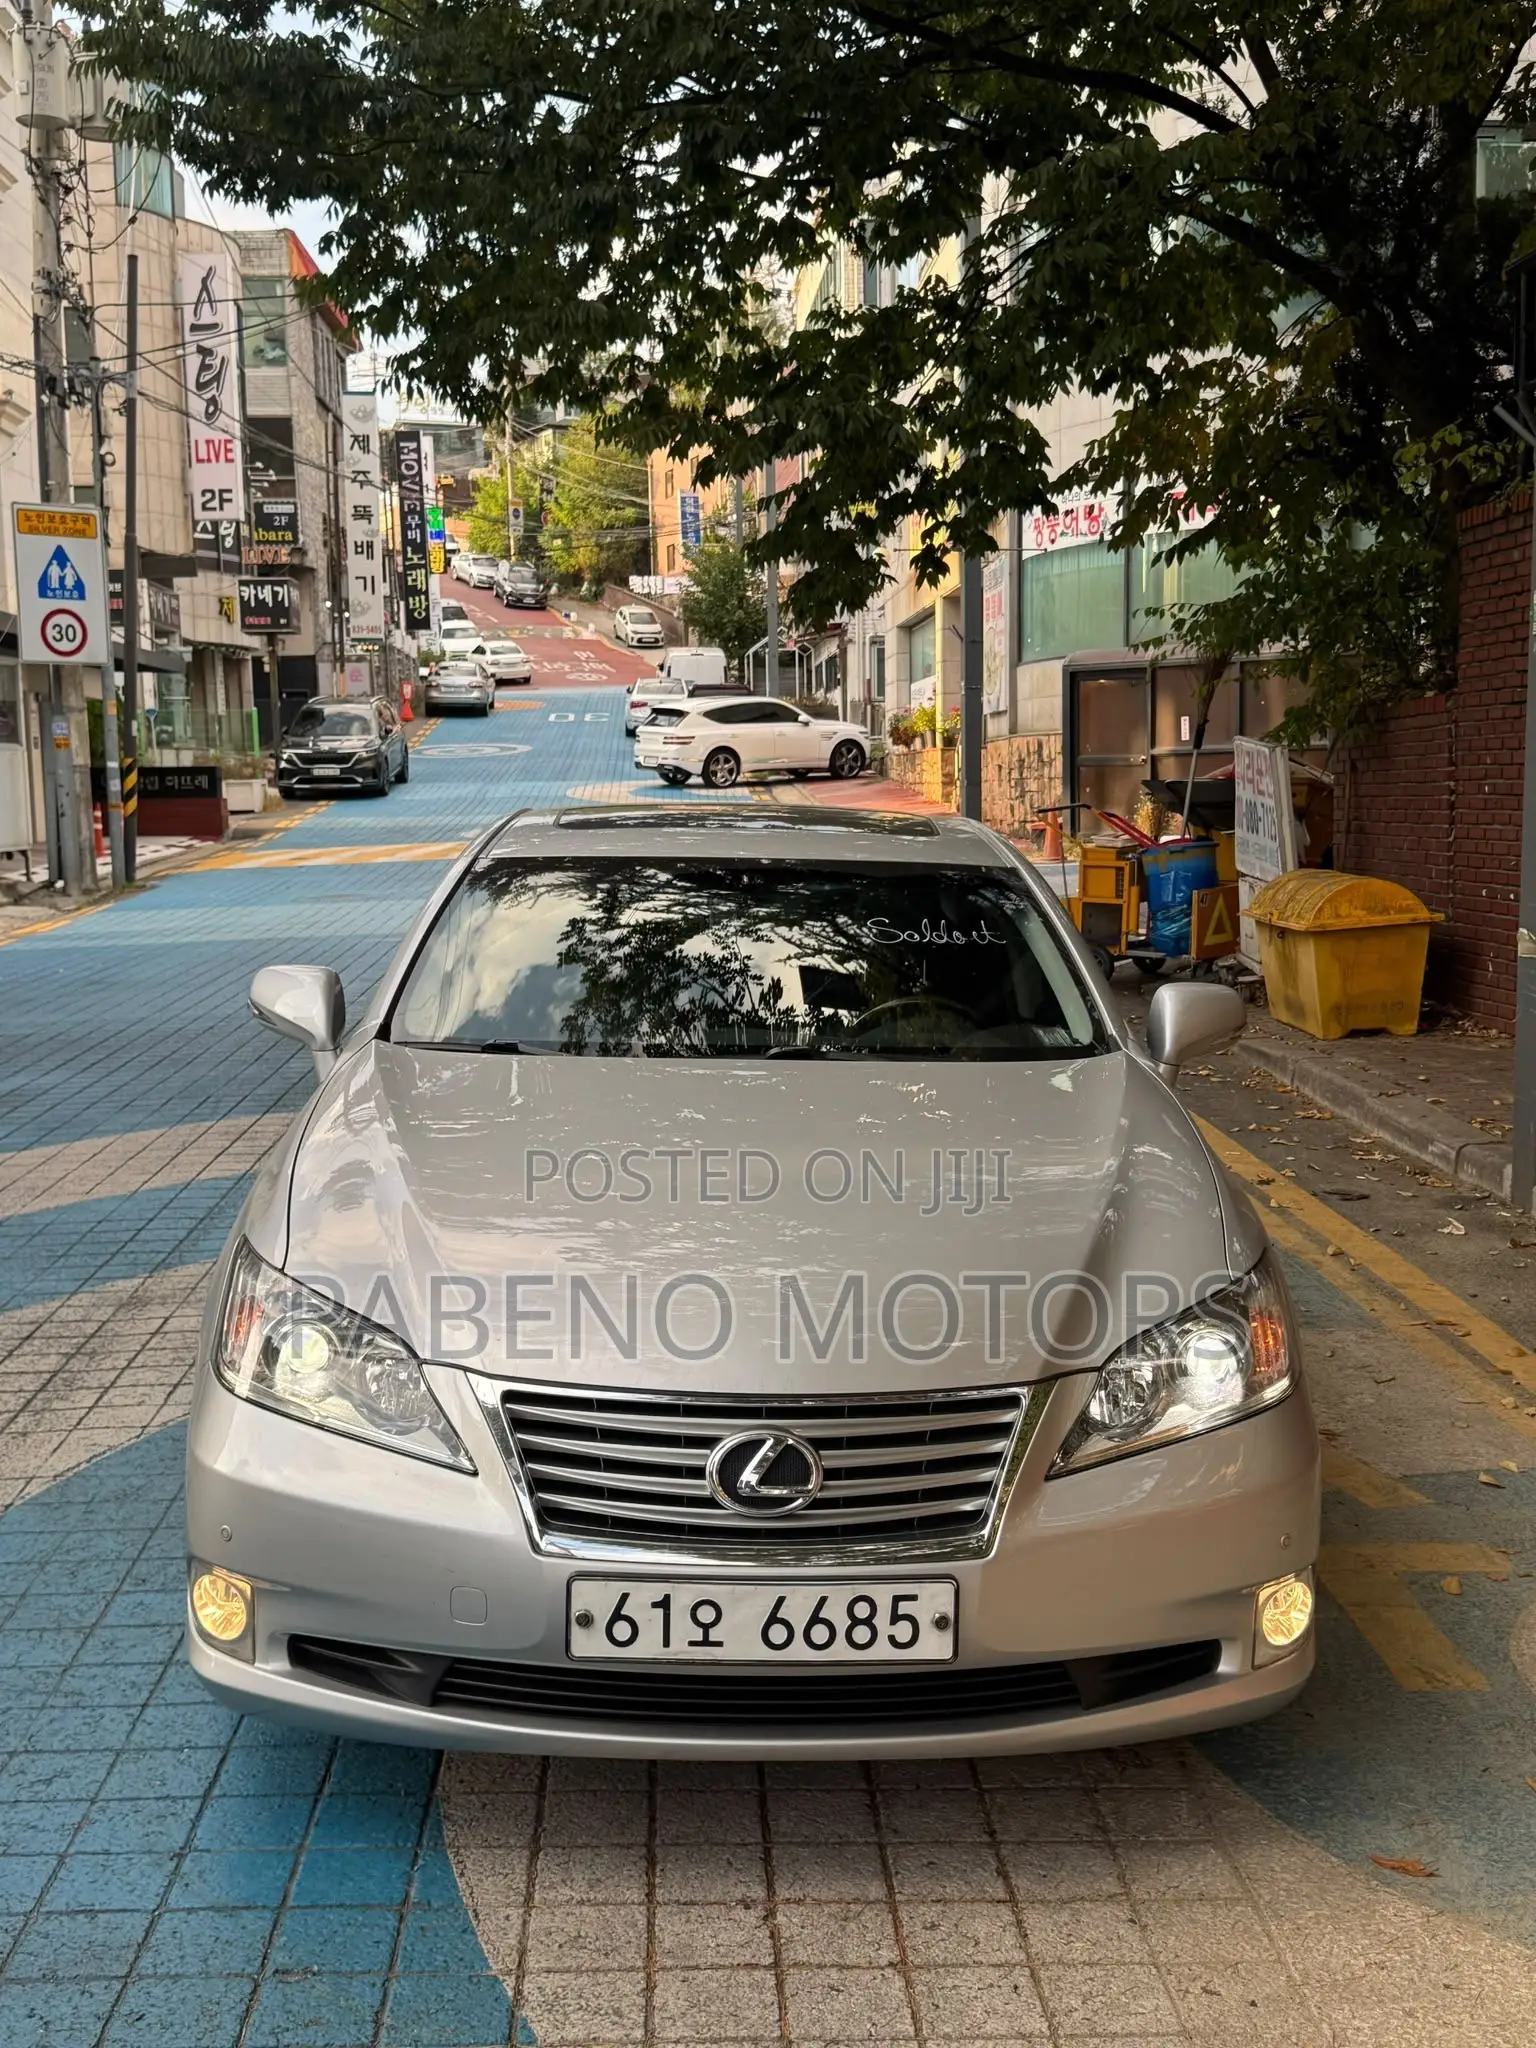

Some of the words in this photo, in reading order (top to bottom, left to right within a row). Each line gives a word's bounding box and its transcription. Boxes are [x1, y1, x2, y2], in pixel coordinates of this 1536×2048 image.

[194, 439, 235, 463] LIVE
[200, 488, 233, 512] 2F
[23, 511, 91, 528] 노인보호구역
[272, 515, 289, 526] 2F
[241, 547, 290, 565] LIVE
[404, 546, 428, 620] 노래방
[240, 584, 289, 608] 카네기
[52, 623, 77, 643] 30
[604, 1591, 725, 1649] 61오
[760, 1593, 921, 1652] 6685
